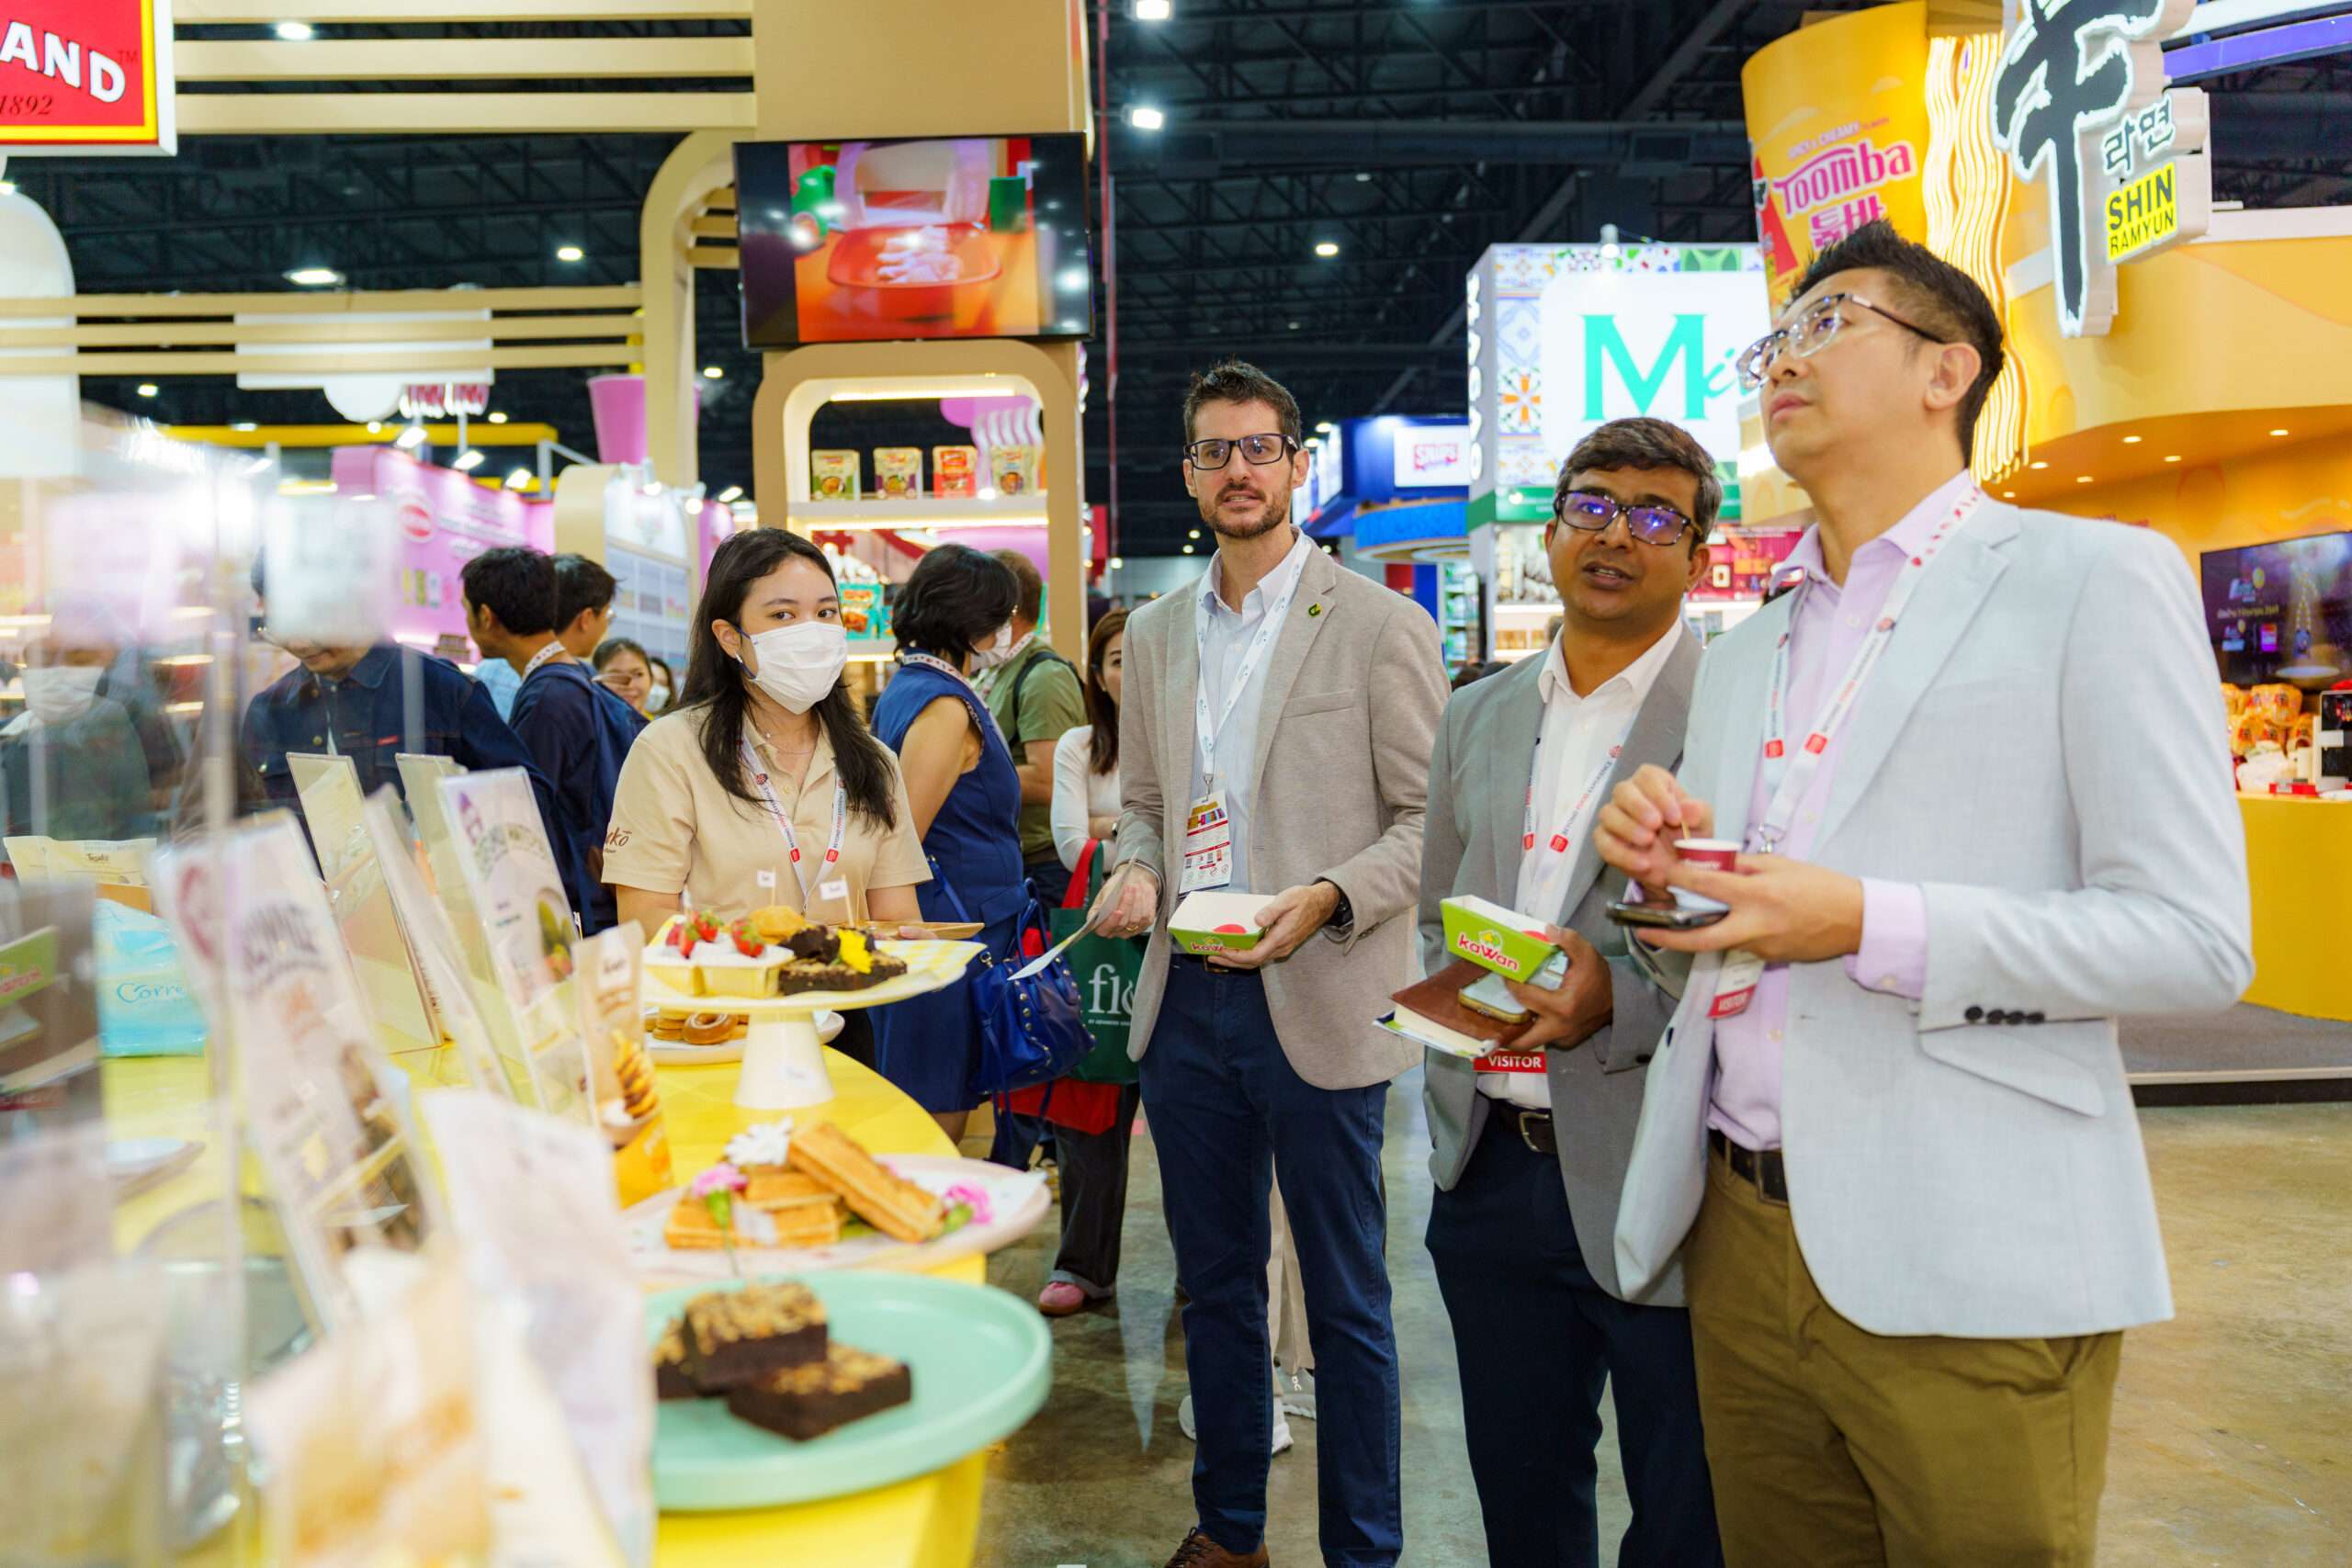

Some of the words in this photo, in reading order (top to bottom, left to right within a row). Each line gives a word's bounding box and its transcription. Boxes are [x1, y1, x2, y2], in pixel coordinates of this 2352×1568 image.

[2109, 169, 2173, 231] SHIN
[2109, 211, 2175, 253] RAMYUN
[1488, 1055, 1543, 1069] VISITOR
